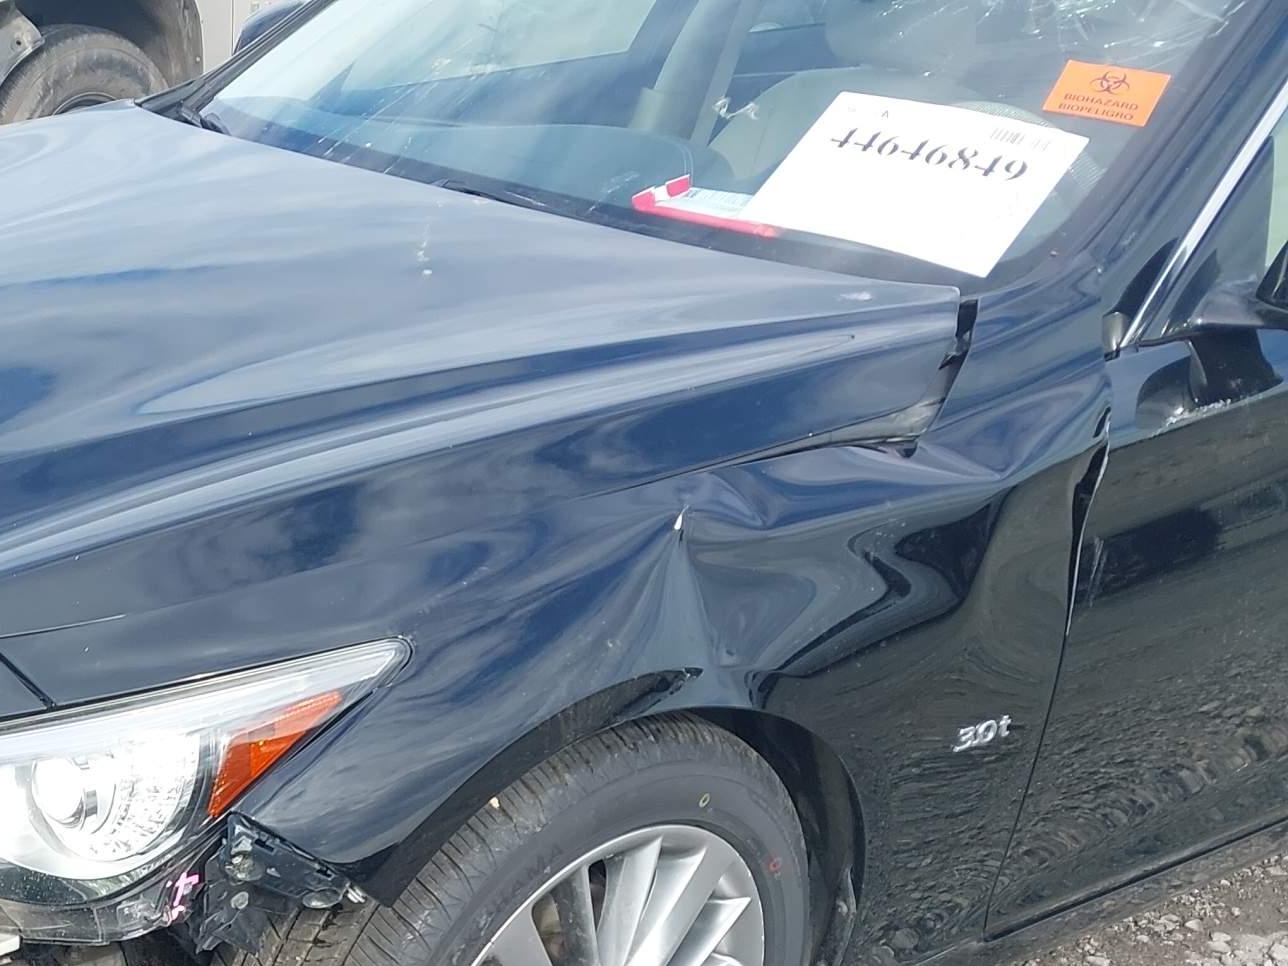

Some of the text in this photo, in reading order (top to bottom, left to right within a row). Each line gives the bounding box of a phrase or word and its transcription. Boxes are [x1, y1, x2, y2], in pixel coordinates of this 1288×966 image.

[1063, 93, 1139, 111] BIOHAZARD
[1058, 103, 1134, 121] BIOPELIGRO
[831, 127, 1028, 181] 44646849
